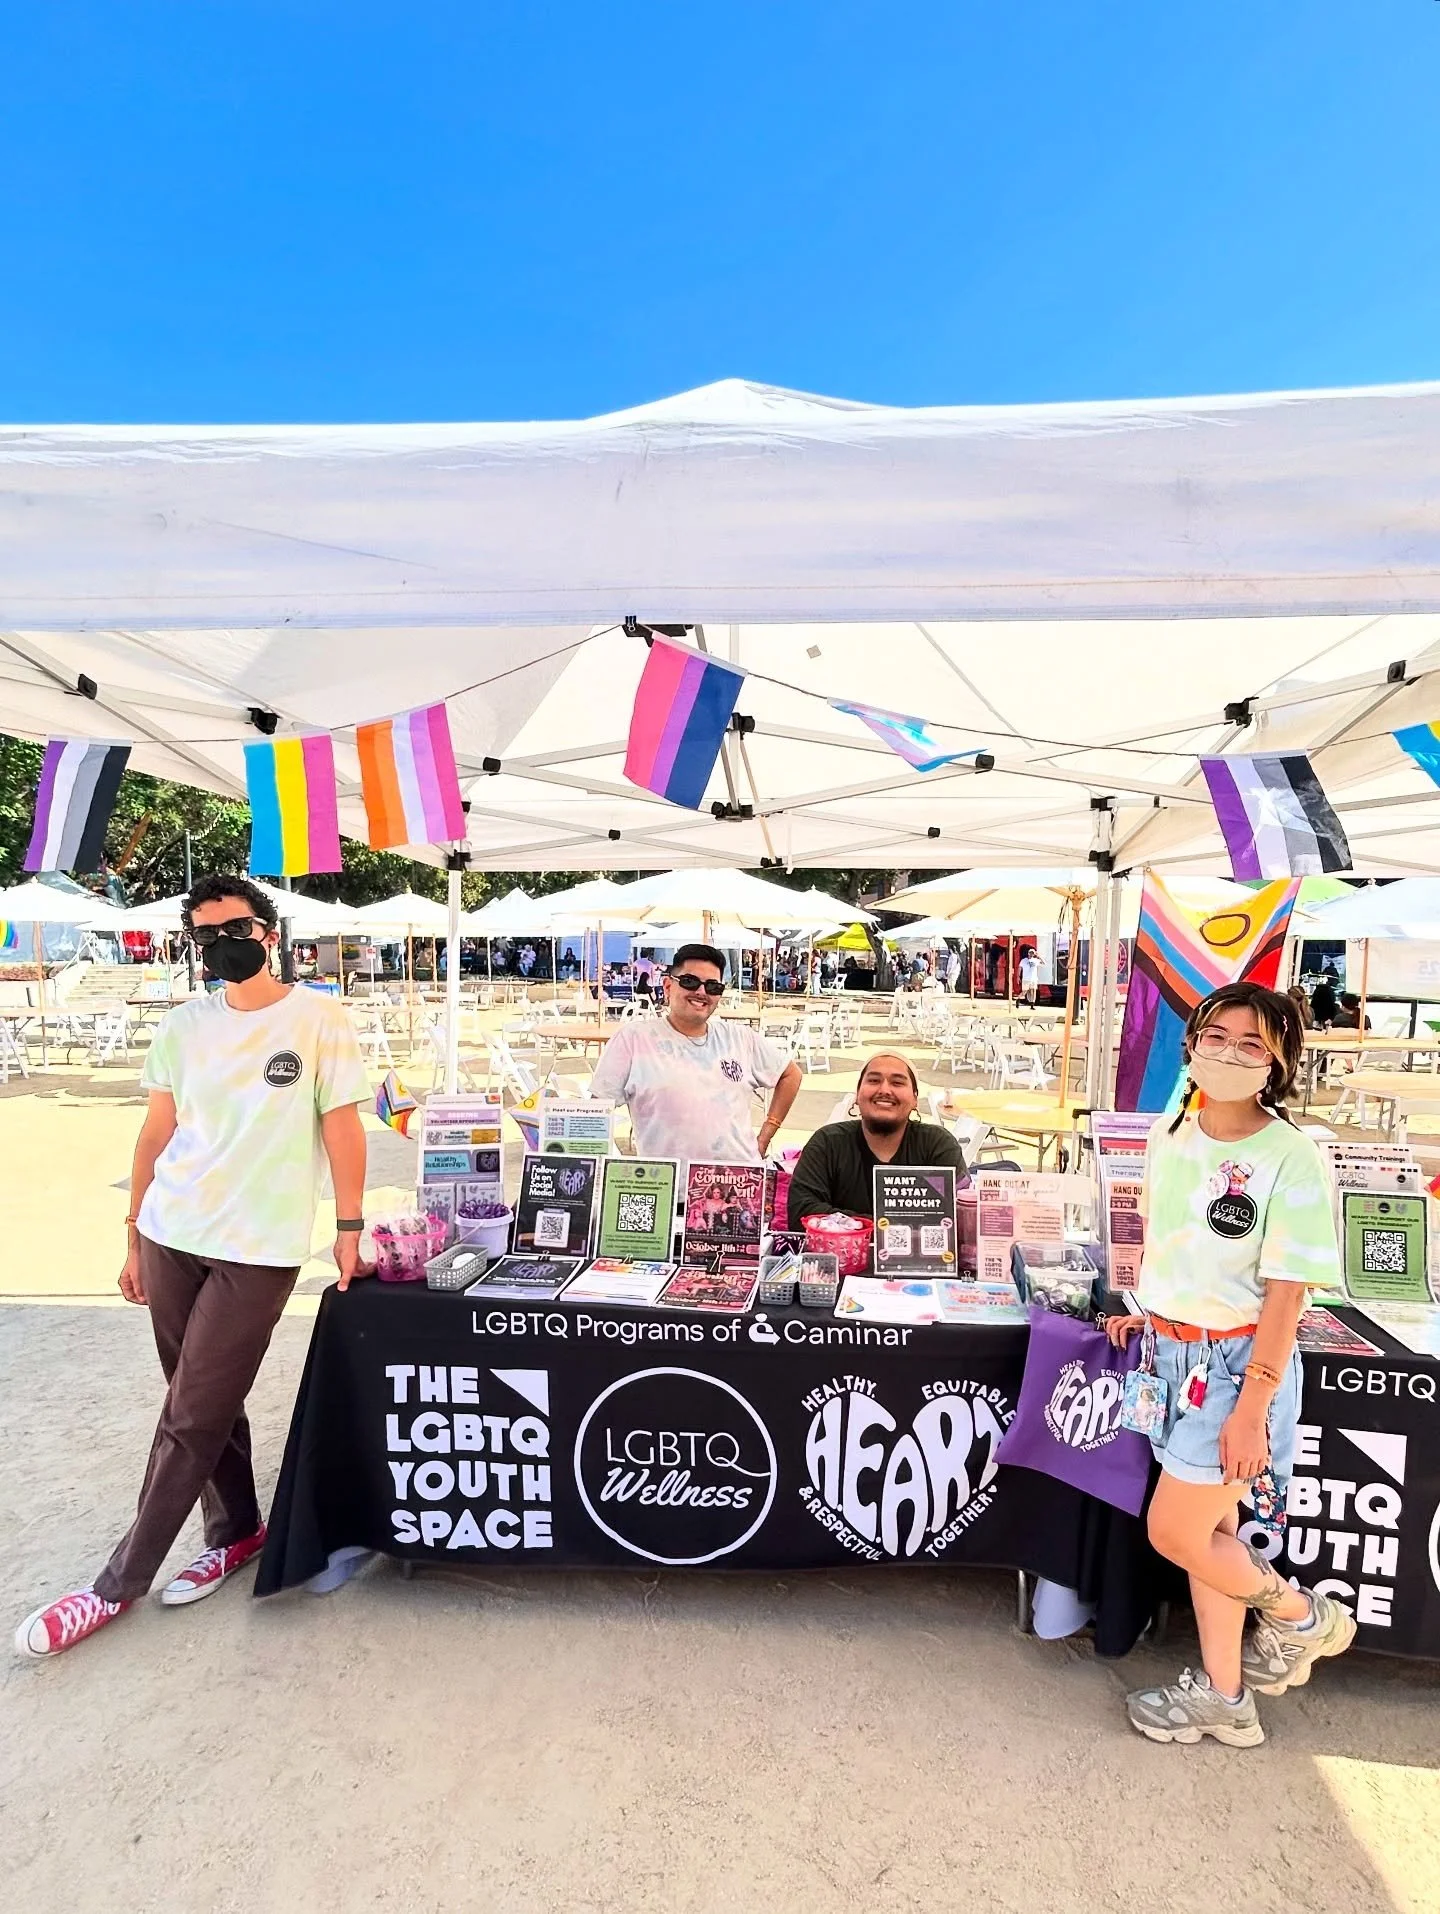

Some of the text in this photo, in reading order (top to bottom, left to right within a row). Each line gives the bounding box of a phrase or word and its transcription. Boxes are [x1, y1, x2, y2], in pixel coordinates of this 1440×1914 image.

[271, 1061, 297, 1070] LGBTQ
[531, 1165, 558, 1174] Follow
[694, 1170, 746, 1188] Coming
[530, 1180, 553, 1189] Social
[883, 1176, 916, 1185] WANT
[1021, 1181, 1030, 1189] AT
[1113, 1185, 1132, 1195] HANG
[528, 1188, 556, 1197] Media!
[883, 1188, 928, 1196] TO STAY
[884, 1199, 941, 1208] IN TOUCH?
[1216, 1202, 1252, 1222] LGBTQ
[1212, 1210, 1250, 1228] Wellness
[686, 1241, 720, 1251] October
[472, 1310, 913, 1346] LGBTQ Programs of Caminar
[385, 1364, 480, 1404] THE
[1319, 1365, 1437, 1403] LGBTQ
[385, 1410, 551, 1458] LGBTQ
[1080, 1434, 1117, 1453] TOGETHER
[606, 1427, 771, 1477] LGBTQ
[387, 1459, 552, 1502] YOUTH
[599, 1467, 754, 1510] Wellness
[1239, 1476, 1403, 1530] BTQ
[390, 1508, 553, 1550] SPACE
[798, 1486, 884, 1561] & RESPECTFUL
[924, 1491, 994, 1558] TOGETHER
